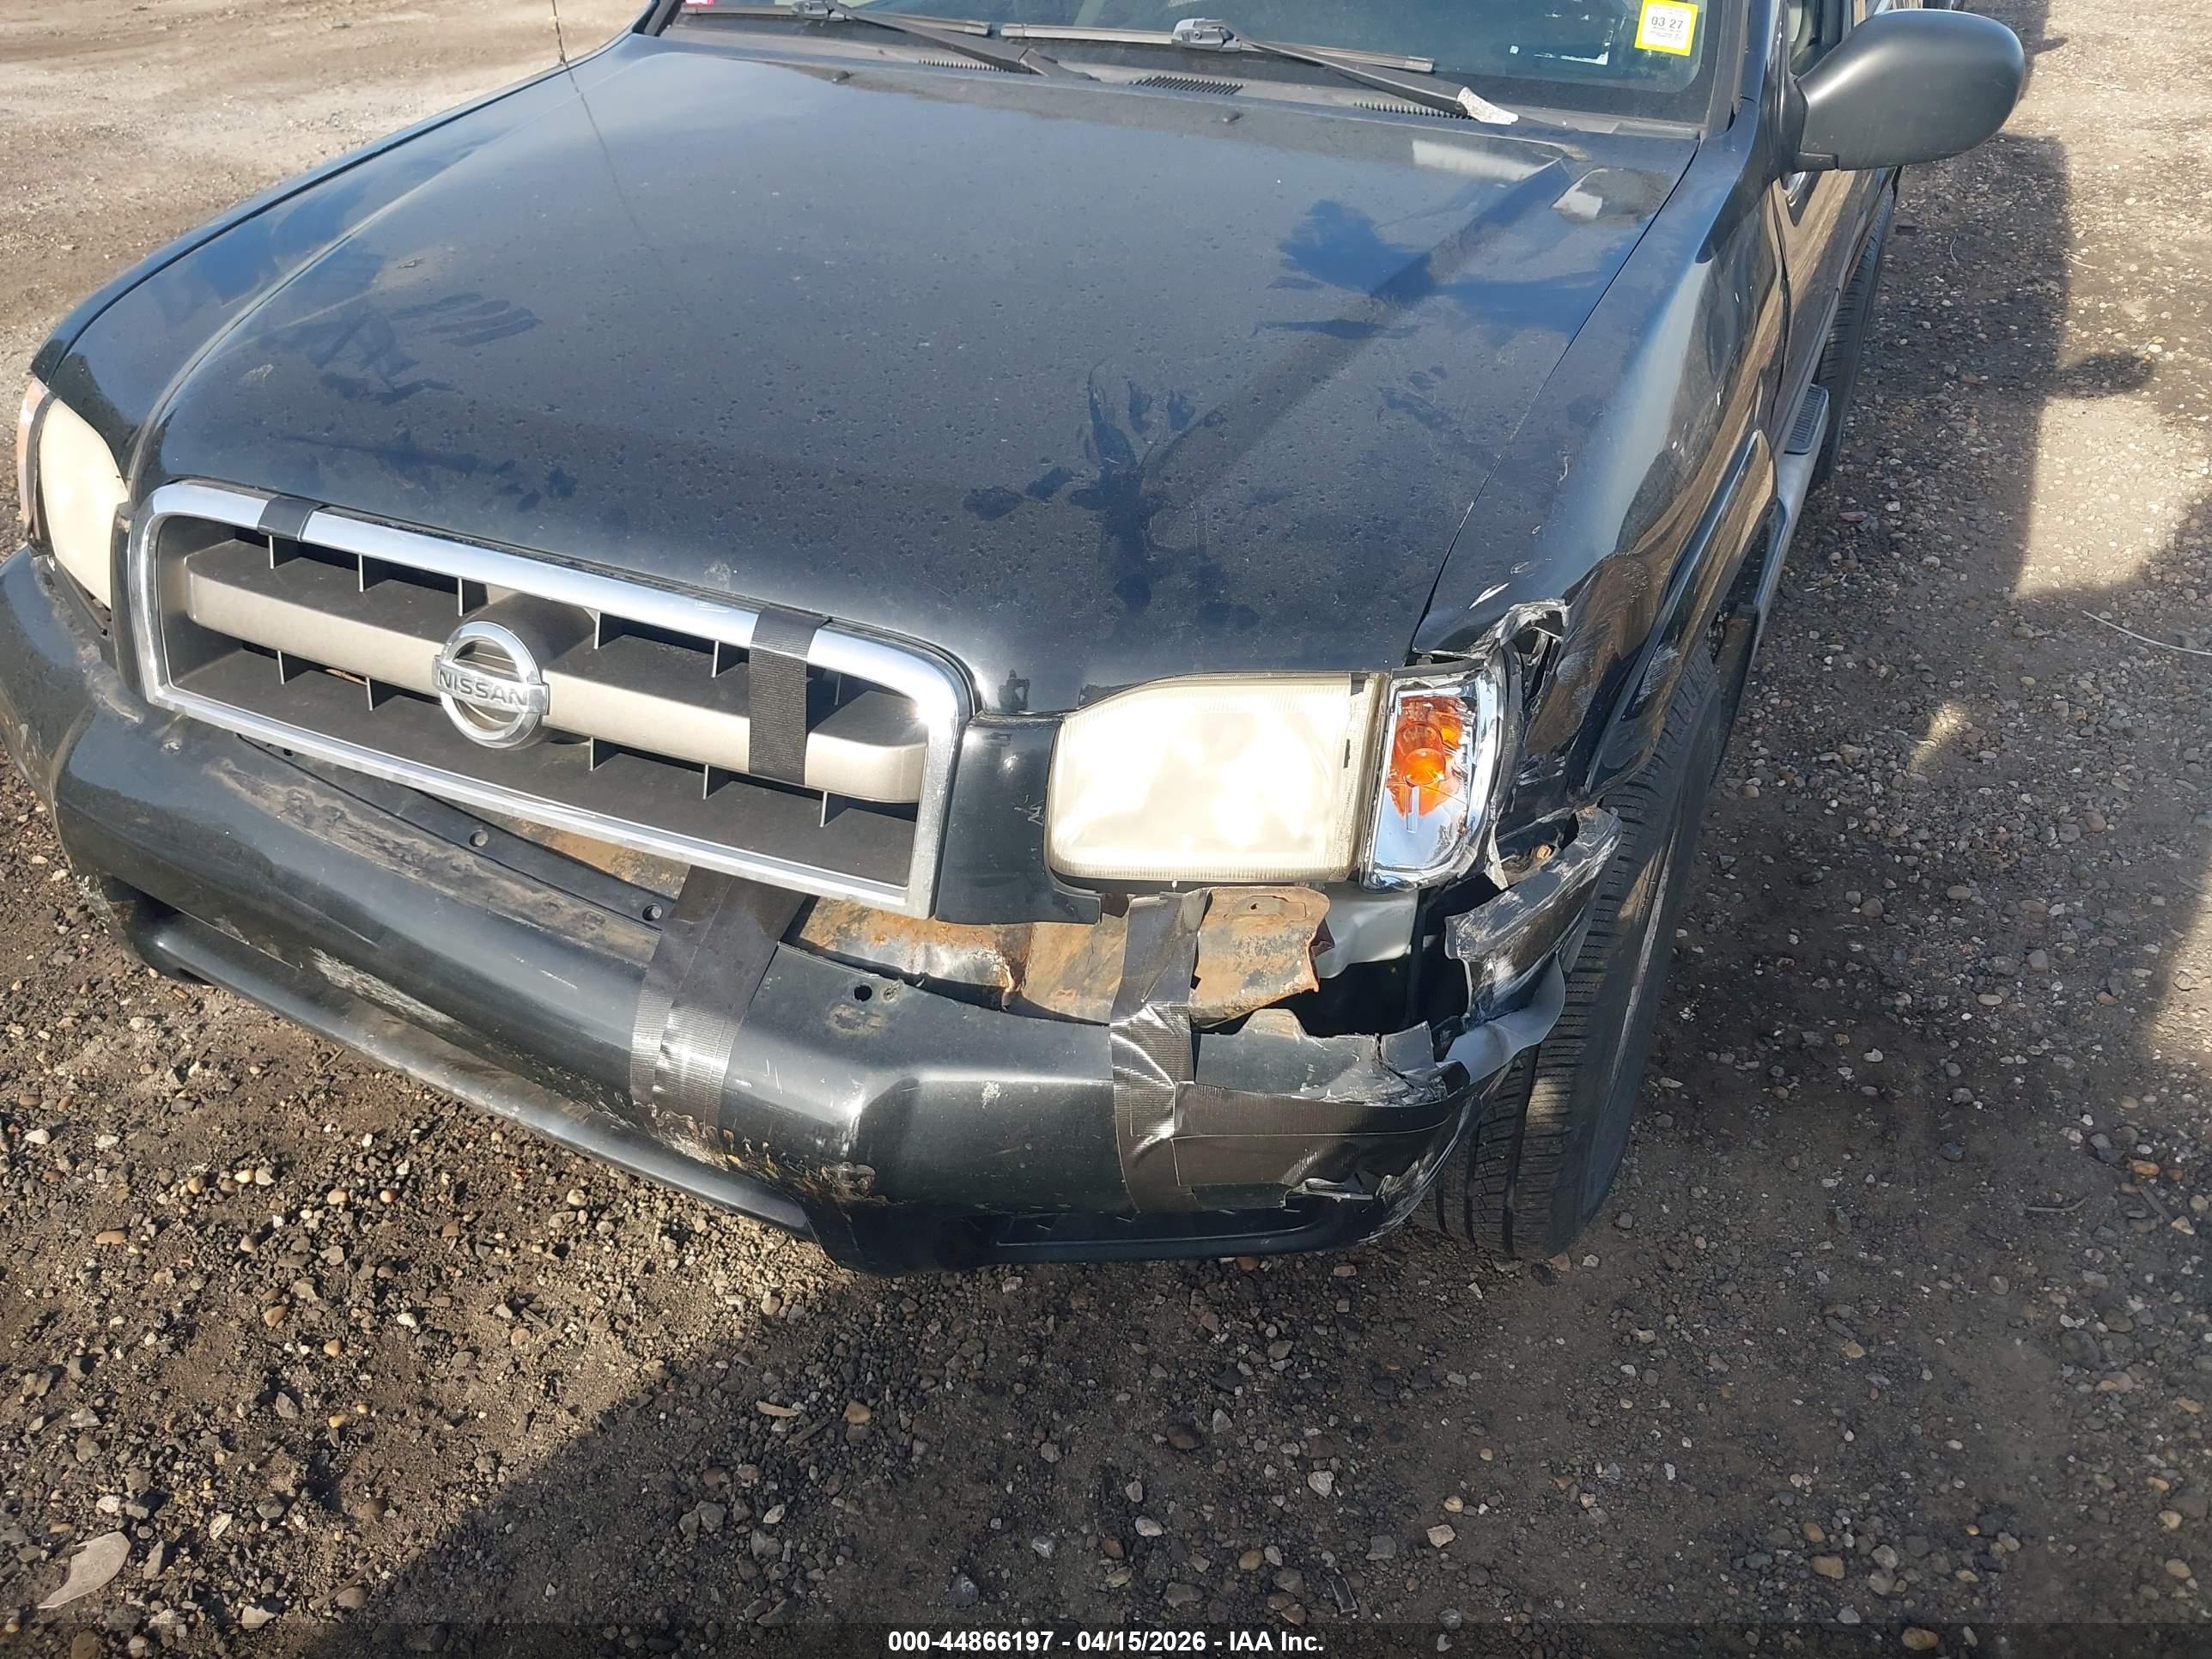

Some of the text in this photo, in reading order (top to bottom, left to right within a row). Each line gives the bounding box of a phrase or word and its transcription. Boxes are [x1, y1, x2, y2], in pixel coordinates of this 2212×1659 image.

[1651, 15, 1684, 30] 03 27
[439, 670, 528, 706] NISSAN
